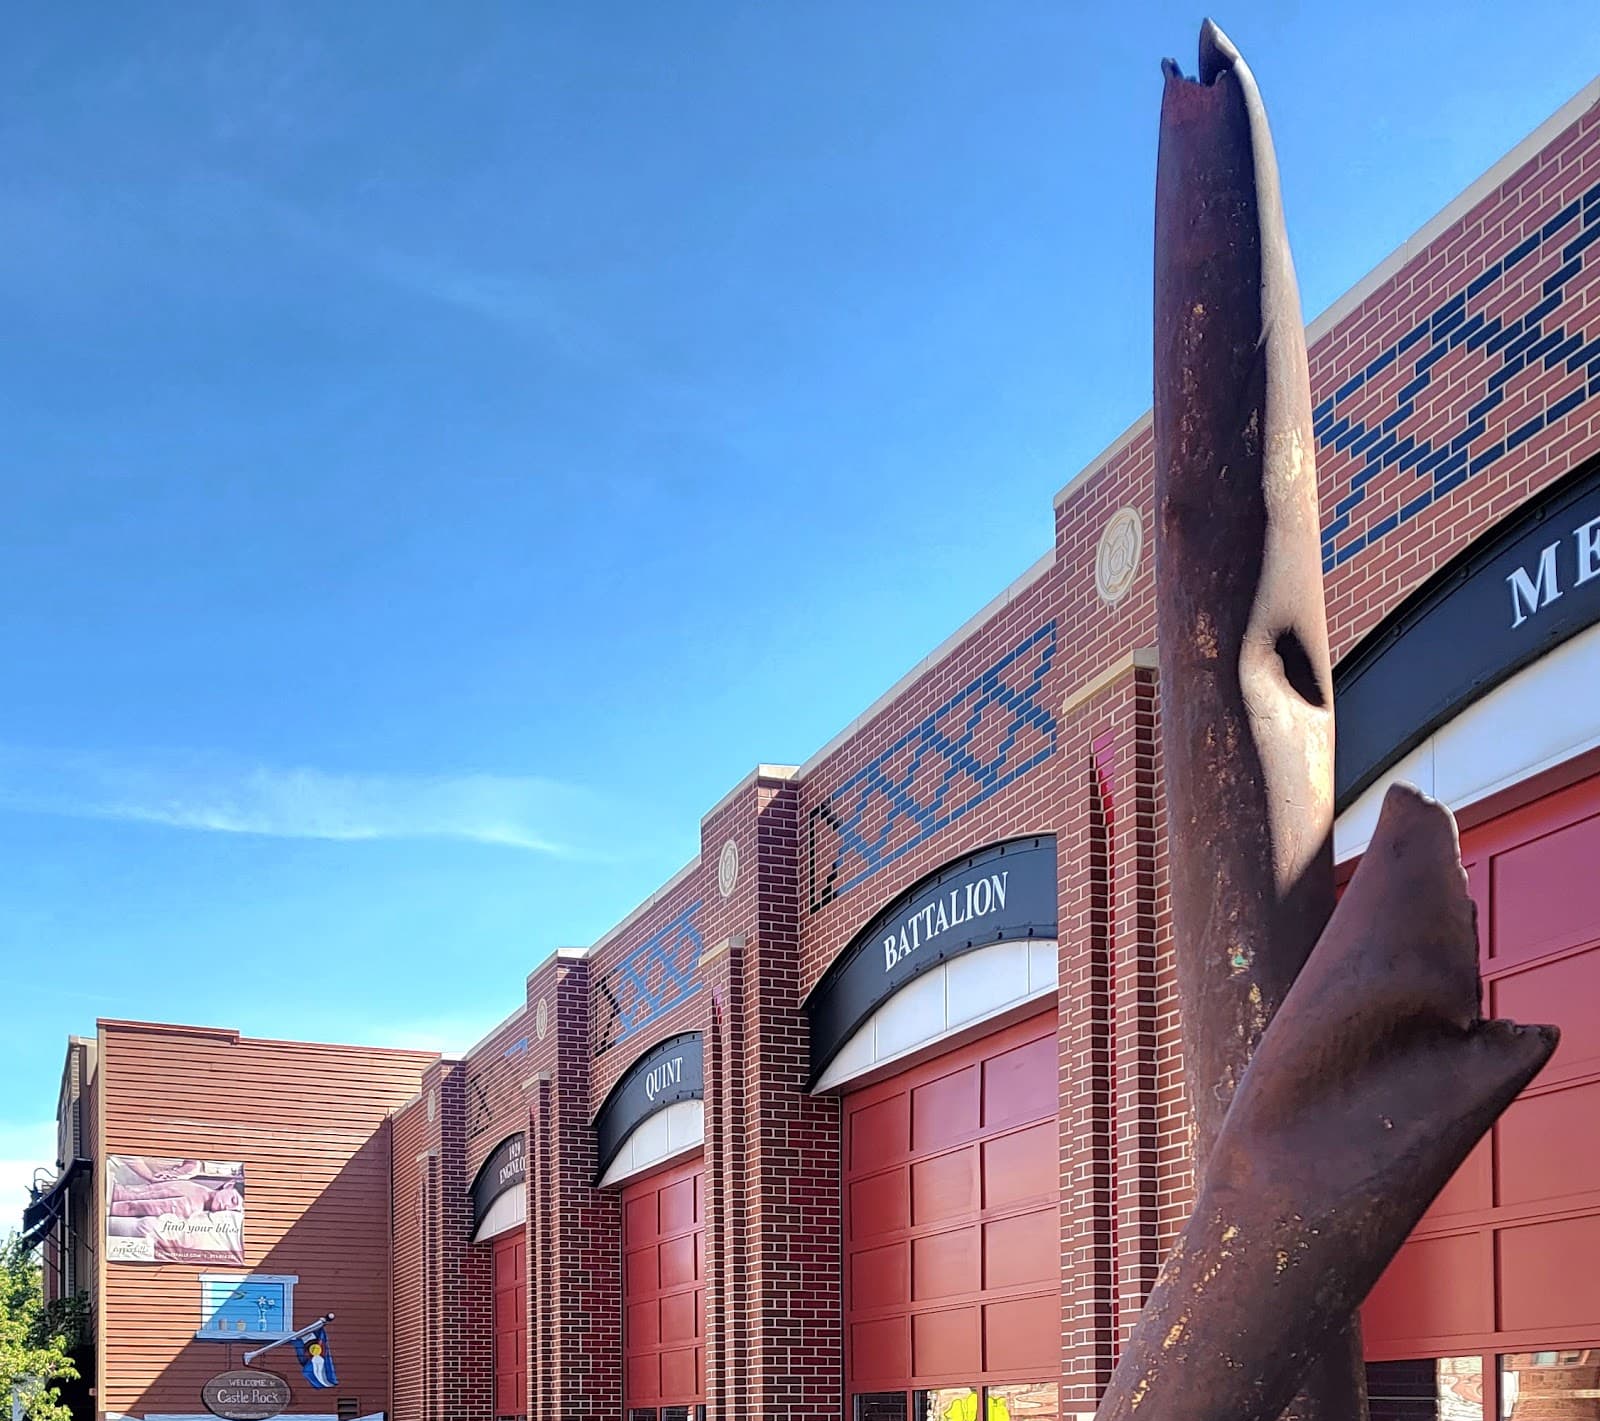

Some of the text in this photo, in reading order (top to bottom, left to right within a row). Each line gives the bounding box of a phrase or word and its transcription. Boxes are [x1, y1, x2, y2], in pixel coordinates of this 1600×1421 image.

[883, 871, 1009, 973] BATTALION
[645, 1056, 683, 1101] QUINT
[161, 1220, 185, 1233] find
[187, 1222, 214, 1234] your
[228, 1379, 267, 1387] WELCOME
[216, 1388, 280, 1404] Castle Rock
